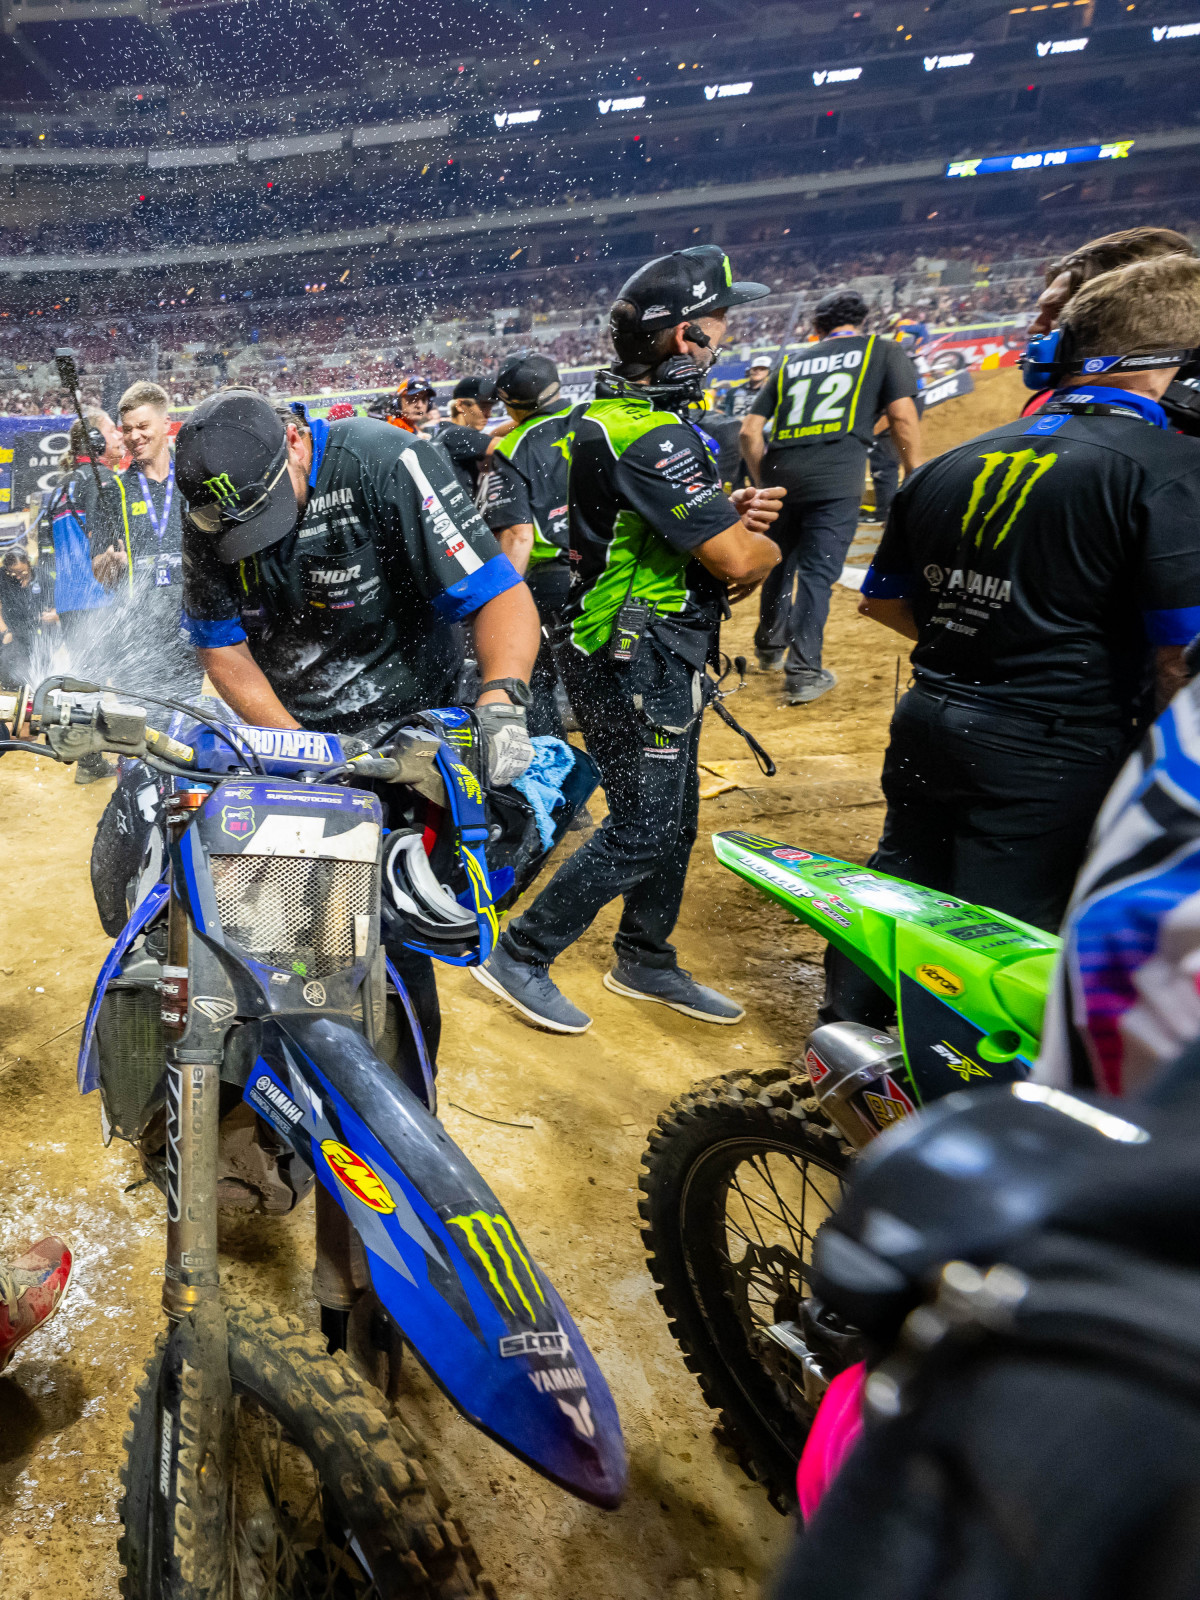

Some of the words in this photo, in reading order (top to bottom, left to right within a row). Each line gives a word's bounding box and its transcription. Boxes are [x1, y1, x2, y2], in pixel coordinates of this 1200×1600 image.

[787, 350, 863, 379] VIDEO
[787, 372, 853, 427] 12
[924, 379, 959, 405] OR
[778, 428, 792, 440] ST.
[794, 424, 823, 438] LOUIS
[662, 456, 695, 476] DUNLOP
[131, 501, 148, 516] 20
[309, 565, 362, 584] THOR
[236, 727, 326, 761] PROTAPER
[266, 793, 342, 804] SUPERMOTOCROSS
[921, 965, 960, 994] vibram
[930, 1044, 985, 1082] SMX
[250, 1089, 271, 1115] FINANCIAL
[270, 1110, 291, 1134] SERVICES
[265, 1083, 304, 1124] YAMAHA
[320, 1143, 398, 1208] FMF
[160, 1406, 174, 1500] BRAKING
[174, 1358, 202, 1584] DUNLOP
